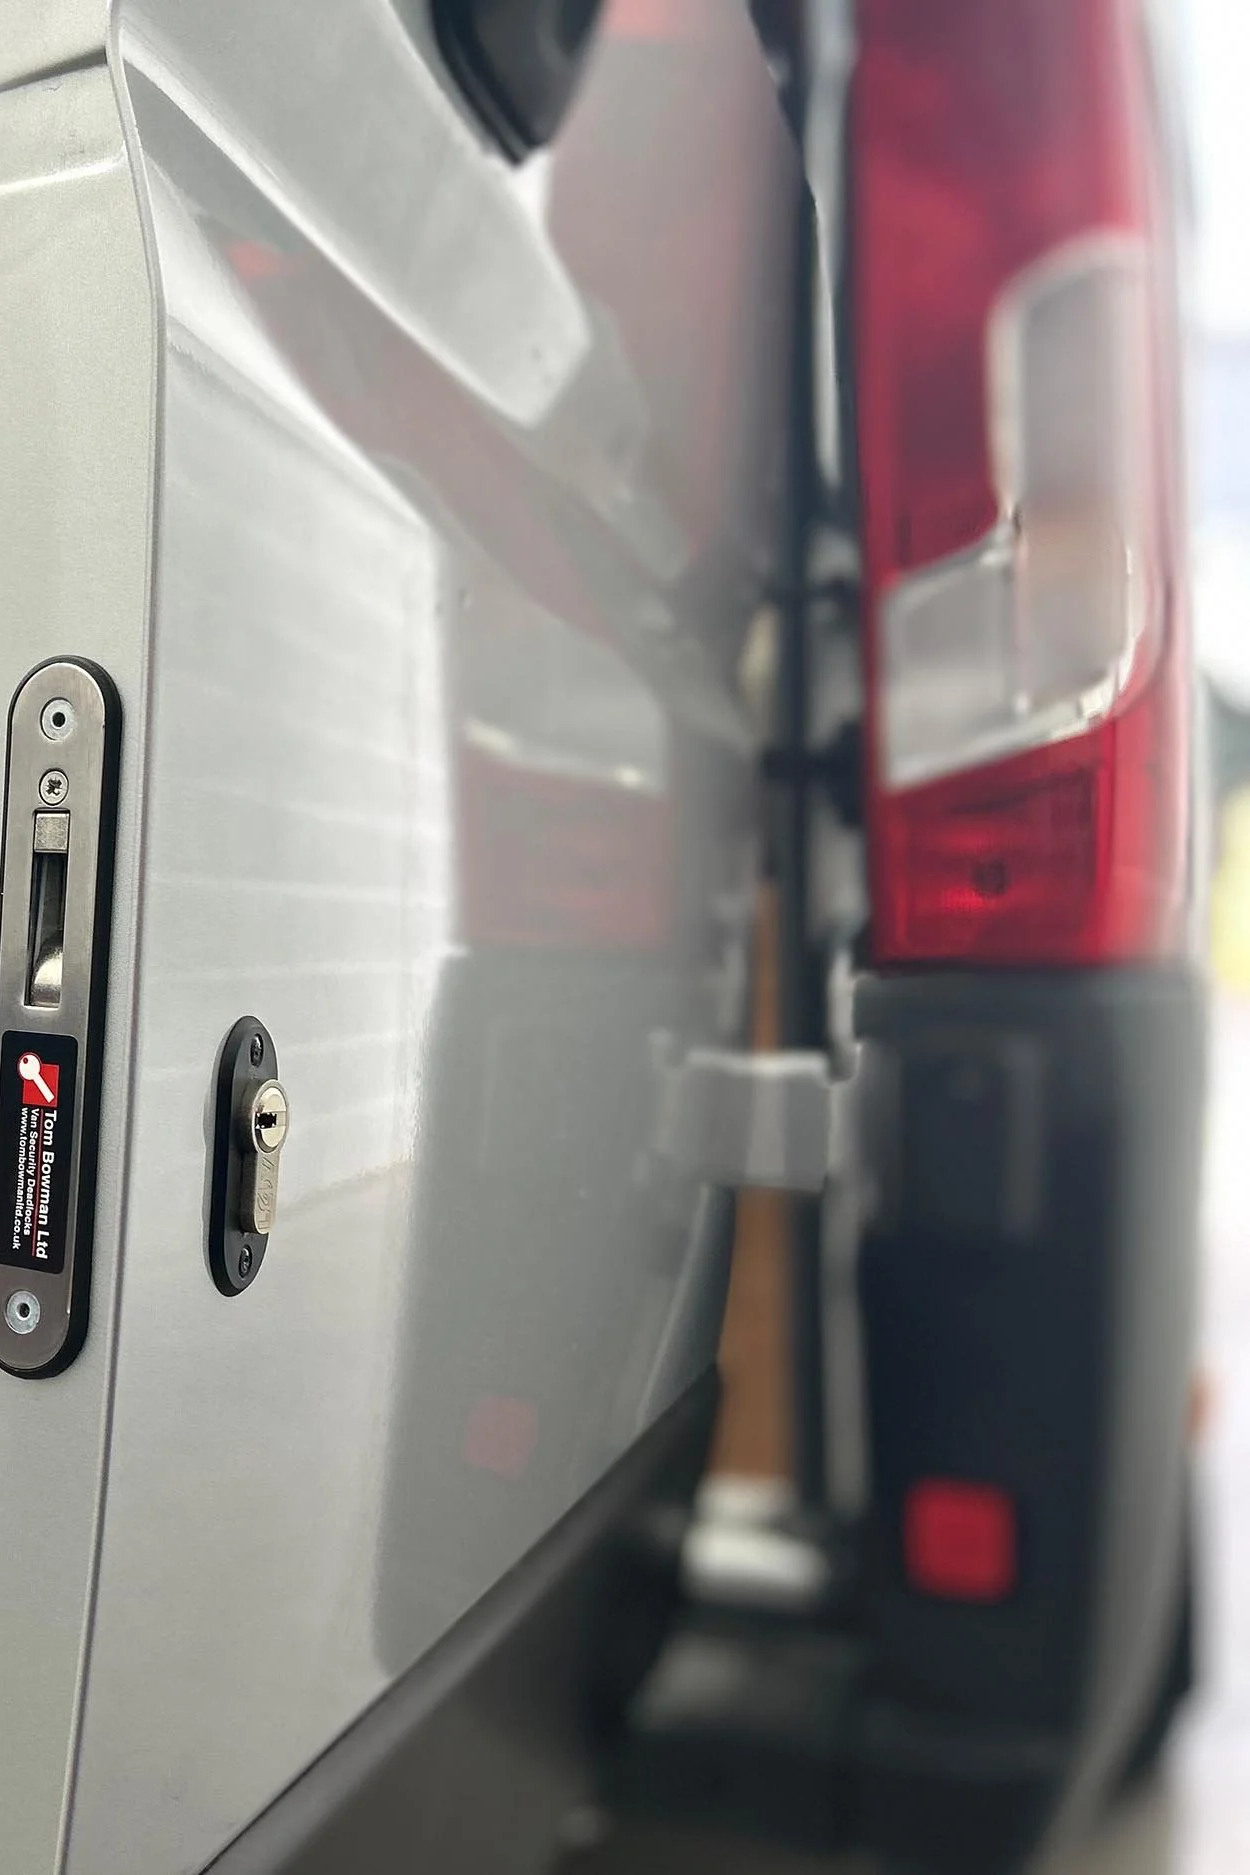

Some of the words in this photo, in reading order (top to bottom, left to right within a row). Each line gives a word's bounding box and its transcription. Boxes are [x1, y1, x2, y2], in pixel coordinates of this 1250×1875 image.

[30, 1108, 40, 1128] Van
[43, 1110, 57, 1146] Tom
[26, 1131, 38, 1176] Security
[12, 1107, 28, 1250] www.tombowmanltd.co.uk
[38, 1151, 55, 1226] Bowman
[23, 1179, 36, 1236] Deadlocks
[36, 1230, 50, 1259] Ltd
